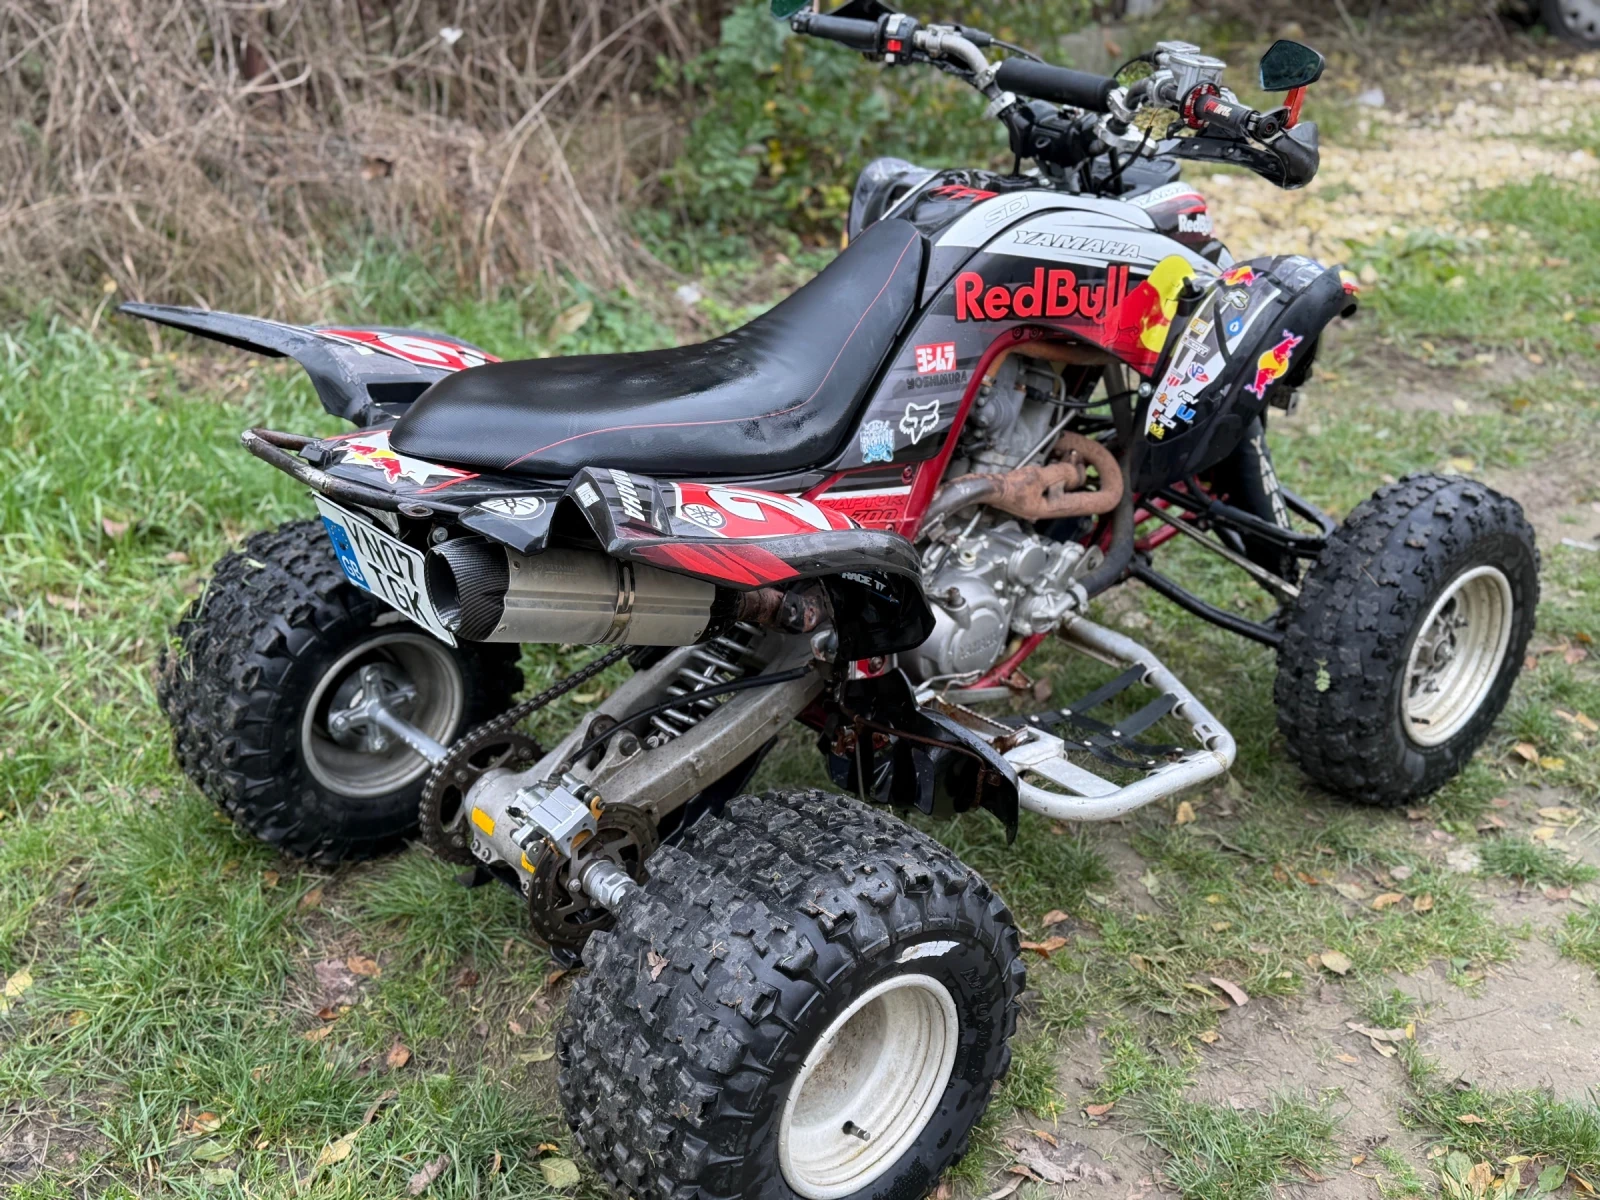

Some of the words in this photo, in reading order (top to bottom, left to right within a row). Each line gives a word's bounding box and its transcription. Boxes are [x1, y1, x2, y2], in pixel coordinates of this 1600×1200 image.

[1013, 231, 1141, 259] YAMAHA
[916, 345, 955, 373] ヨシムラ
[906, 370, 968, 390] YOSHIMURA
[1250, 435, 1290, 529] YAMAH
[851, 509, 898, 524] 700
[341, 515, 417, 587] YN07
[341, 555, 364, 582] GB
[367, 560, 432, 628] TGK
